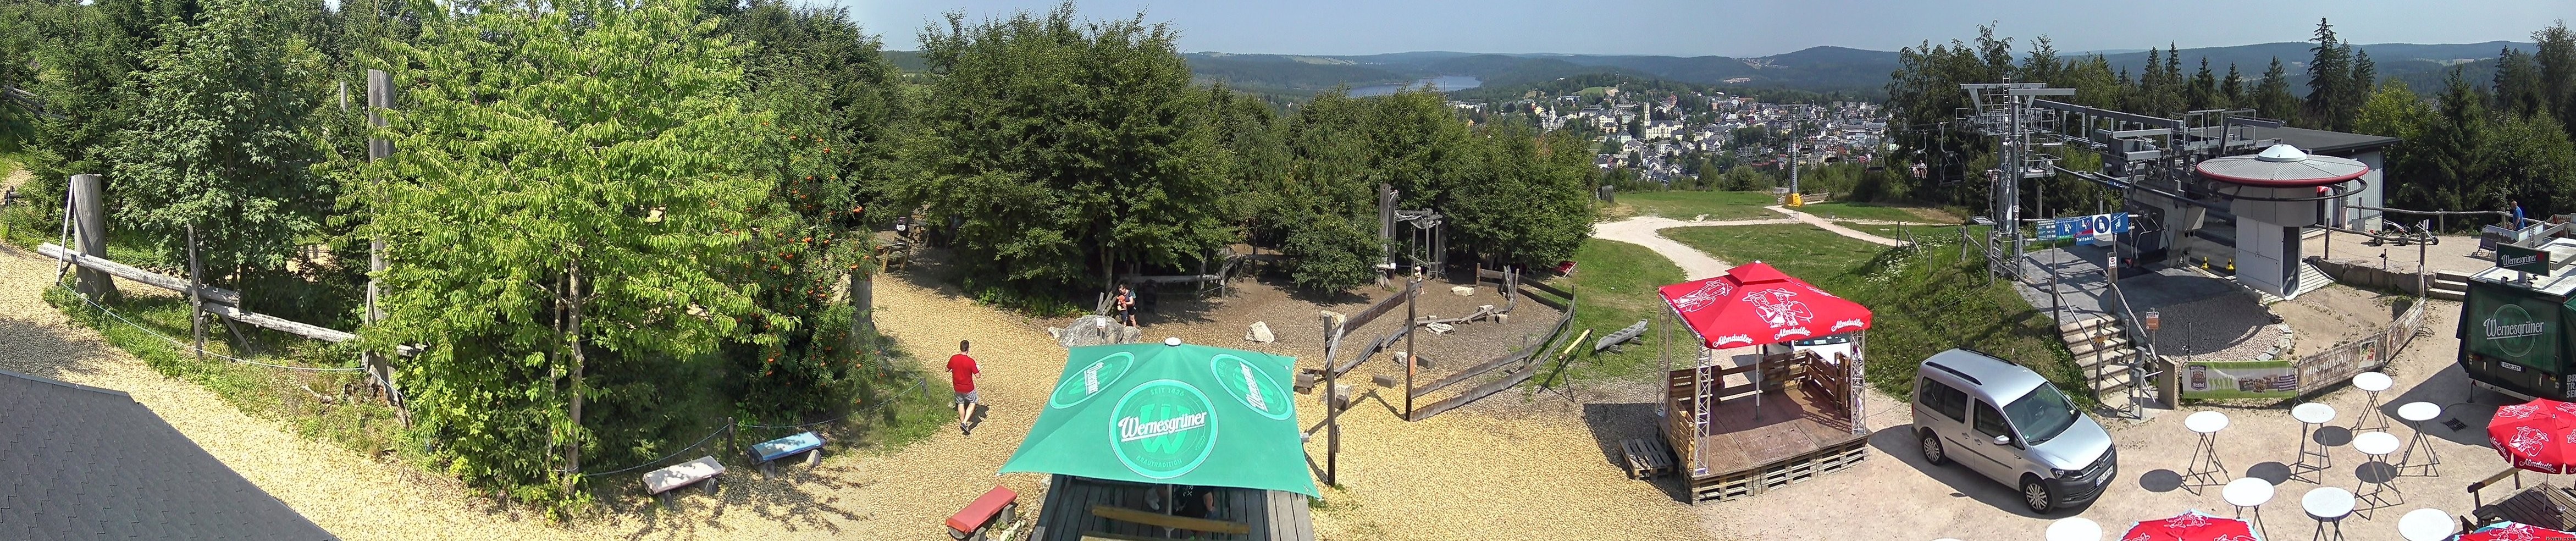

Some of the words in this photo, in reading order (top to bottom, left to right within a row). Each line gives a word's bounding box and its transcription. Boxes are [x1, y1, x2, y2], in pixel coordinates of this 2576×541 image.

[2501, 254, 2537, 266] Wernesgrüner
[1831, 318, 1865, 332] Almdudler
[2483, 317, 2544, 338] Wernesgrüner
[1712, 333, 1754, 347] Almdudler
[1775, 326, 1811, 340] Almdudler
[1150, 387, 1165, 396] SEIT
[1168, 388, 1185, 396] 1436
[1118, 412, 1207, 440] Wernesgrüner
[1136, 455, 1182, 468] BRAUTRADITION
[2519, 458, 2557, 473] Almdudler
